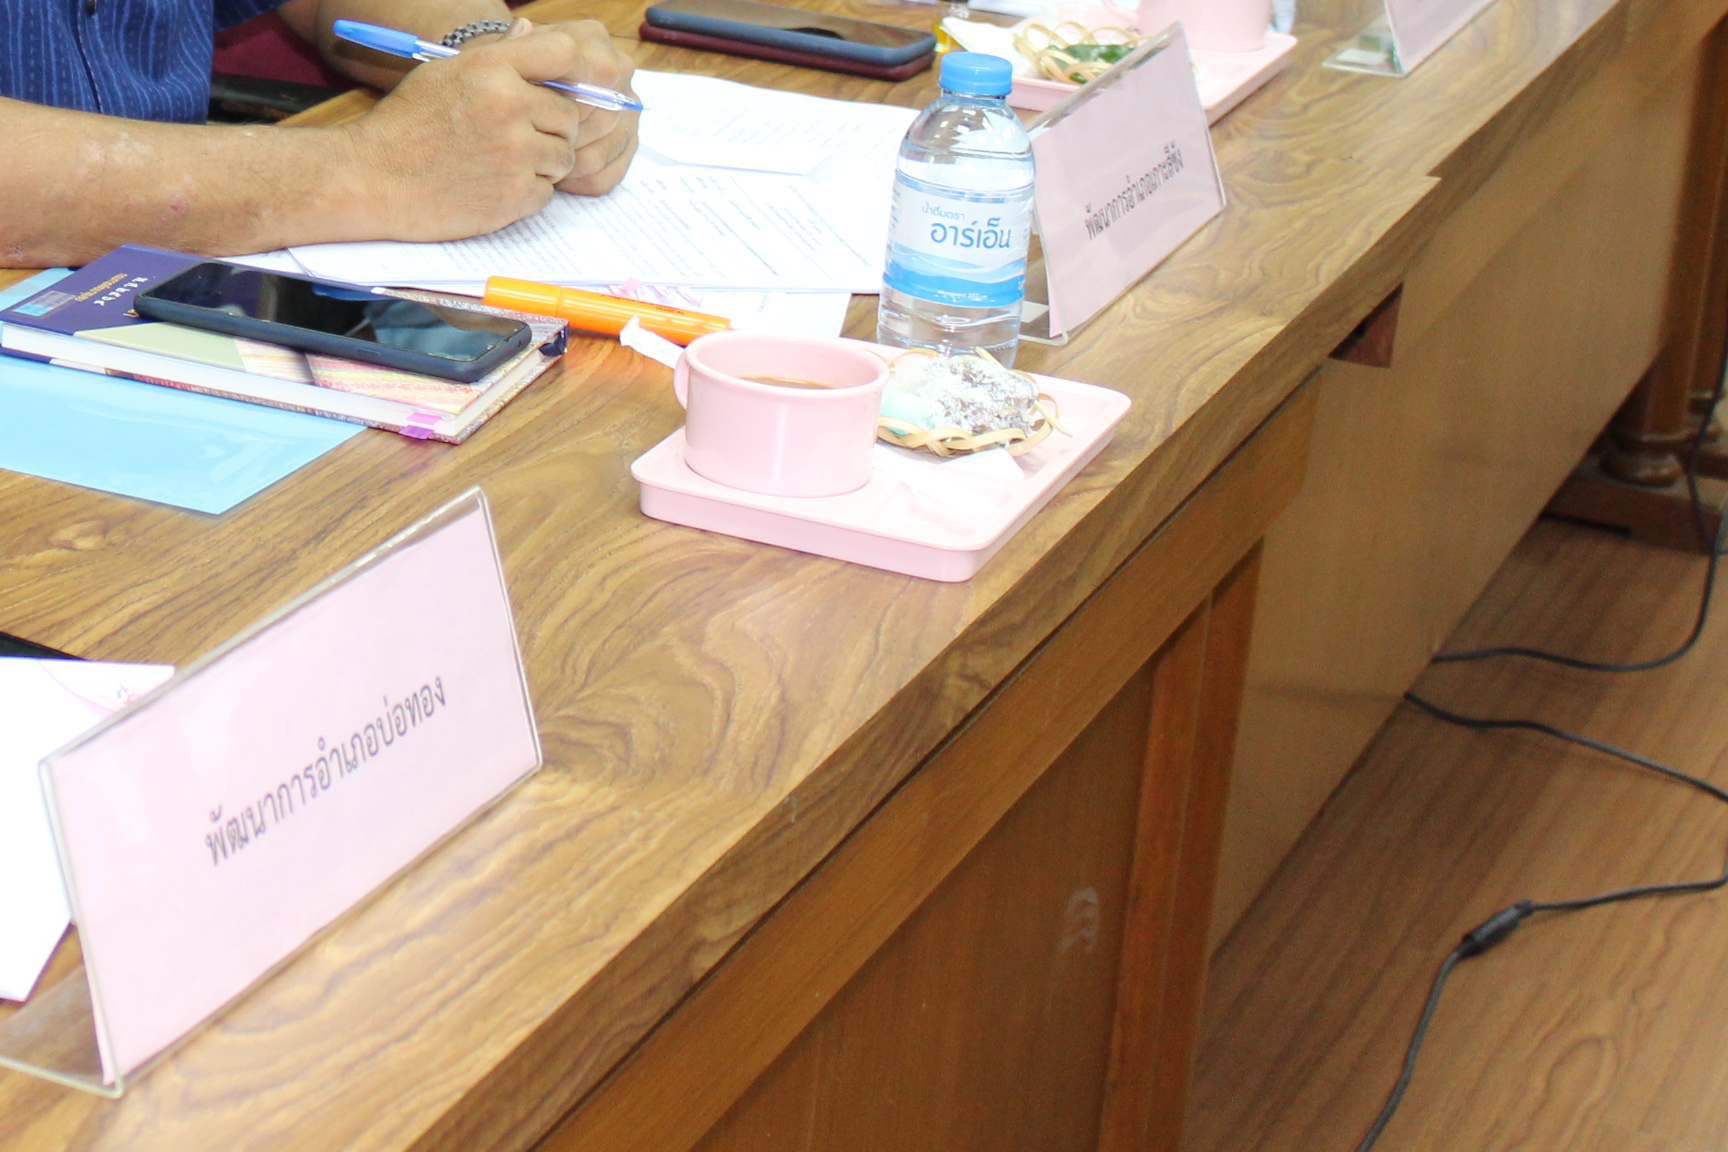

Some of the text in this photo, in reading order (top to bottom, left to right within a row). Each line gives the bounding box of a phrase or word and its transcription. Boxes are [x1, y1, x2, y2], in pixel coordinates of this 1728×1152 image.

[930, 218, 1011, 249] อาร์เอ็น
[205, 676, 446, 866] พัฒนาการอำเภอบ่อทอง
